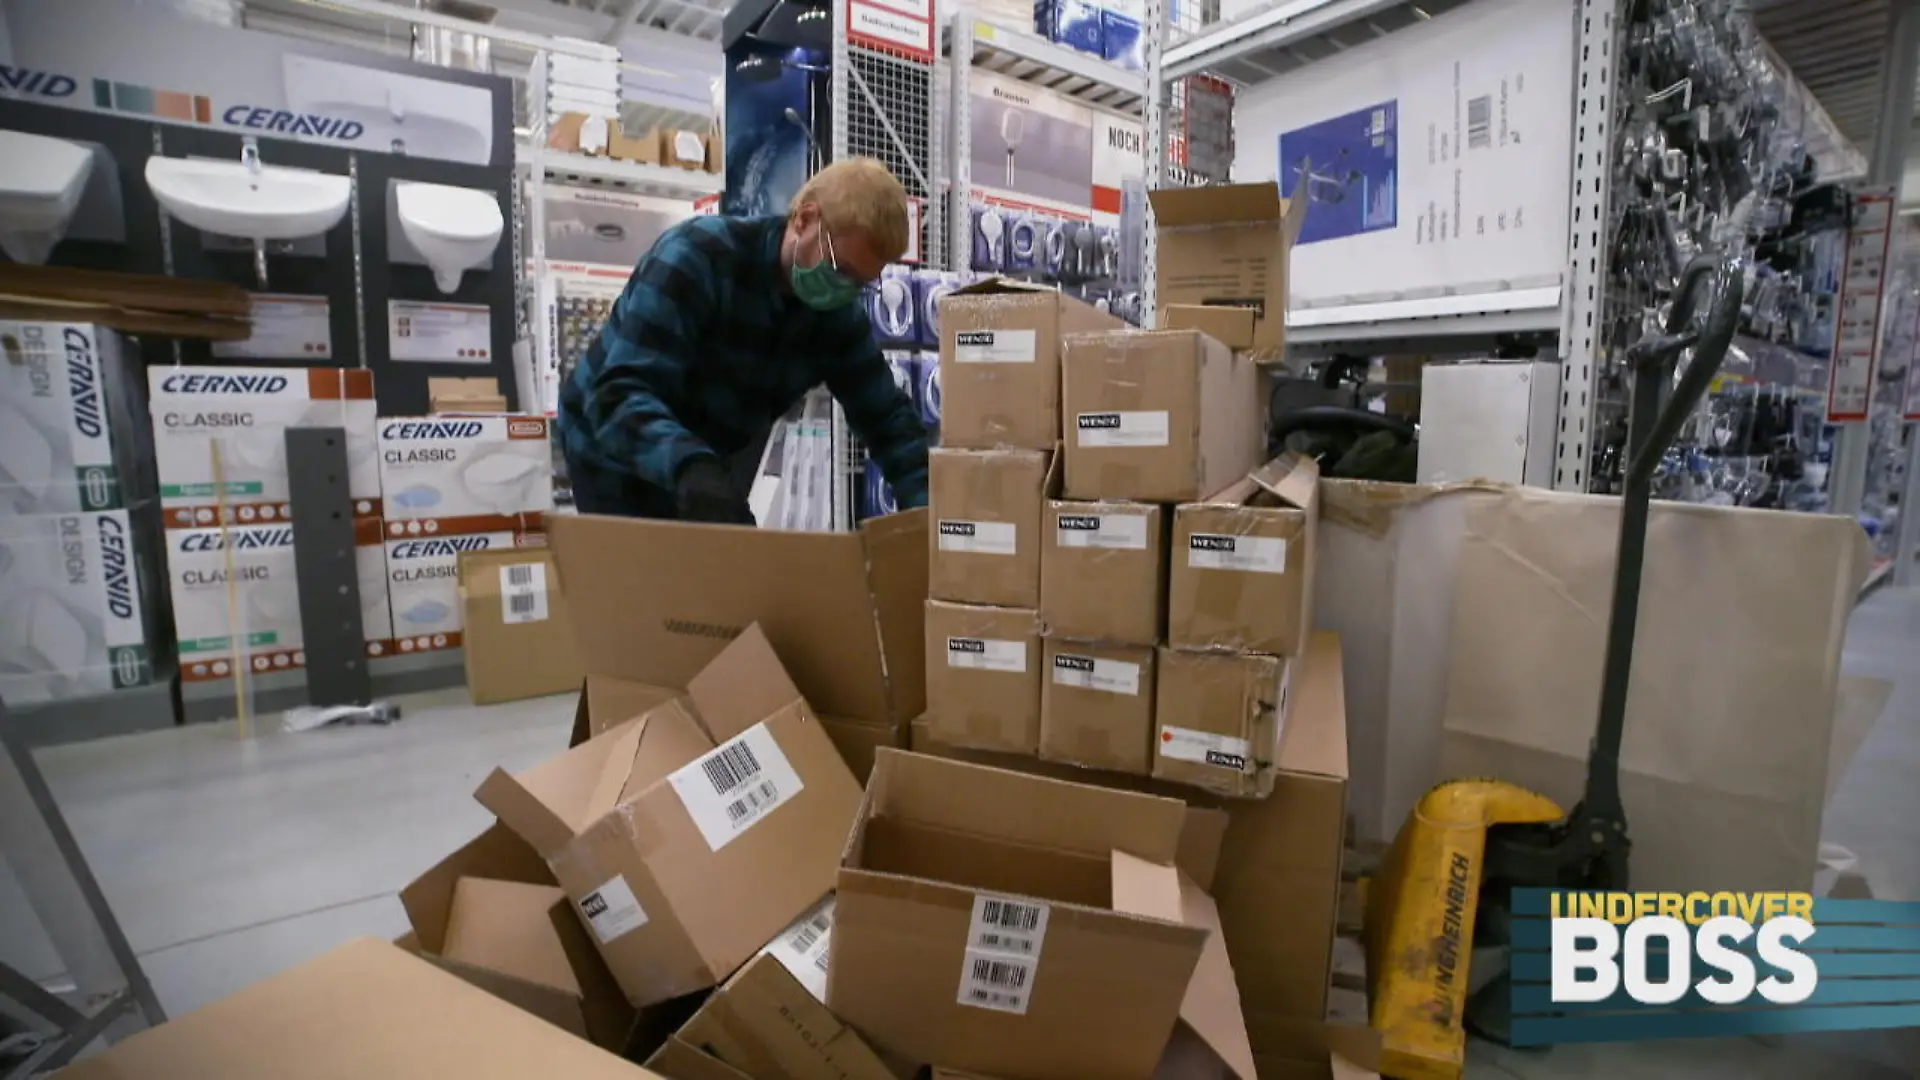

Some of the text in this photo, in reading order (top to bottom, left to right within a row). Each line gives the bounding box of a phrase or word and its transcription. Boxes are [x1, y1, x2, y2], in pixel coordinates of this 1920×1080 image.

[0, 64, 77, 97] VID
[223, 105, 363, 140] CERAVID
[1108, 126, 1140, 152] NOCH
[23, 325, 53, 397] DESIGN
[63, 327, 101, 438] CERAVID
[162, 374, 288, 394] CERAVID
[163, 412, 254, 428] CLASSIC
[383, 422, 483, 440] CERAVID
[385, 449, 456, 464] CLASSIC
[60, 517, 88, 585] DESIGN
[391, 536, 490, 559] CERAVID
[97, 515, 133, 620] CERAVID
